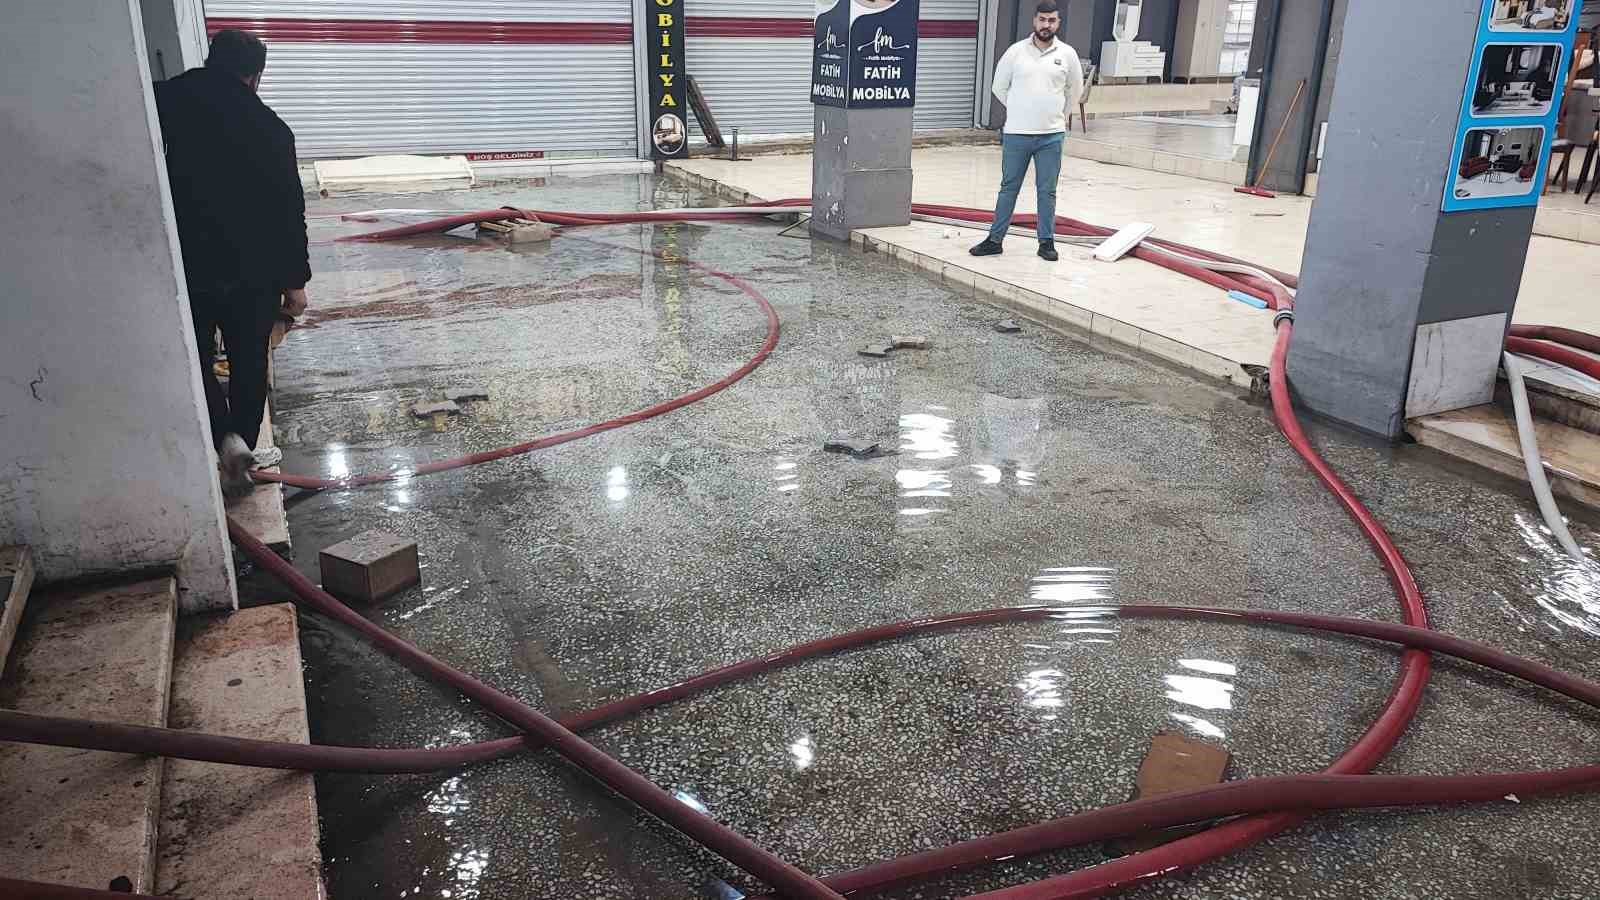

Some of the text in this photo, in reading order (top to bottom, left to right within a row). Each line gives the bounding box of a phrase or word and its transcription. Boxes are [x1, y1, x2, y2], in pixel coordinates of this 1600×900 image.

[857, 26, 910, 53] fm
[820, 63, 841, 78] FATİH
[864, 65, 901, 80] FATİH
[812, 83, 845, 99] MOBİLYA
[852, 85, 911, 100] MOBİLYA
